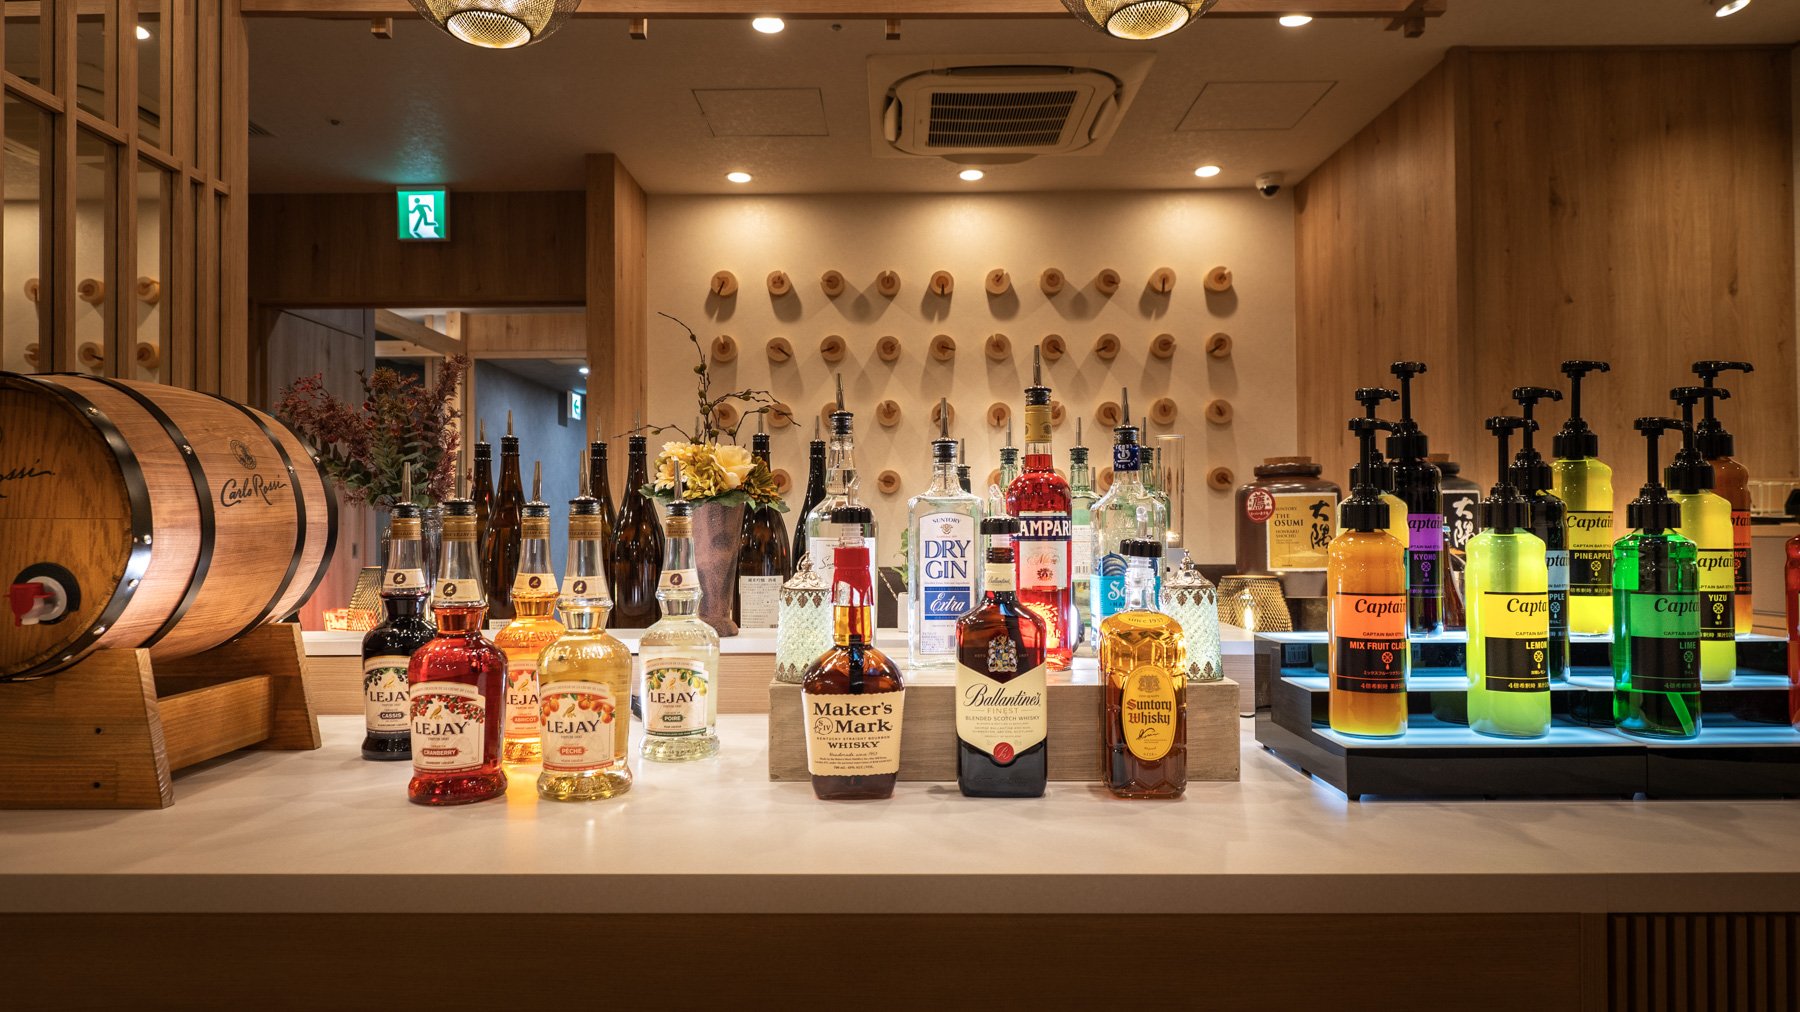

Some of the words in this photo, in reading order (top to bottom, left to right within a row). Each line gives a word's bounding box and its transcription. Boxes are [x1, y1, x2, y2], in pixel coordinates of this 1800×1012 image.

[221, 478, 252, 507] Carlo
[252, 474, 287, 505] Rossi
[1012, 520, 1071, 537] AMPARI
[924, 540, 971, 558] DRY
[925, 560, 967, 579] GIN
[930, 592, 965, 613] Extra
[1350, 641, 1365, 649] MIX
[1367, 642, 1390, 650] FRUIT
[370, 691, 409, 702] LEJA
[651, 691, 696, 703] LEJAY
[963, 683, 1041, 707] Ballantine's
[813, 702, 892, 716] Maker's
[1127, 699, 1171, 712] Suntory
[1128, 712, 1170, 725] Whisky
[415, 722, 467, 735] LEJAY
[547, 720, 599, 733] LEJAY
[834, 719, 892, 734] Mark
[828, 741, 880, 749] WHISKY
